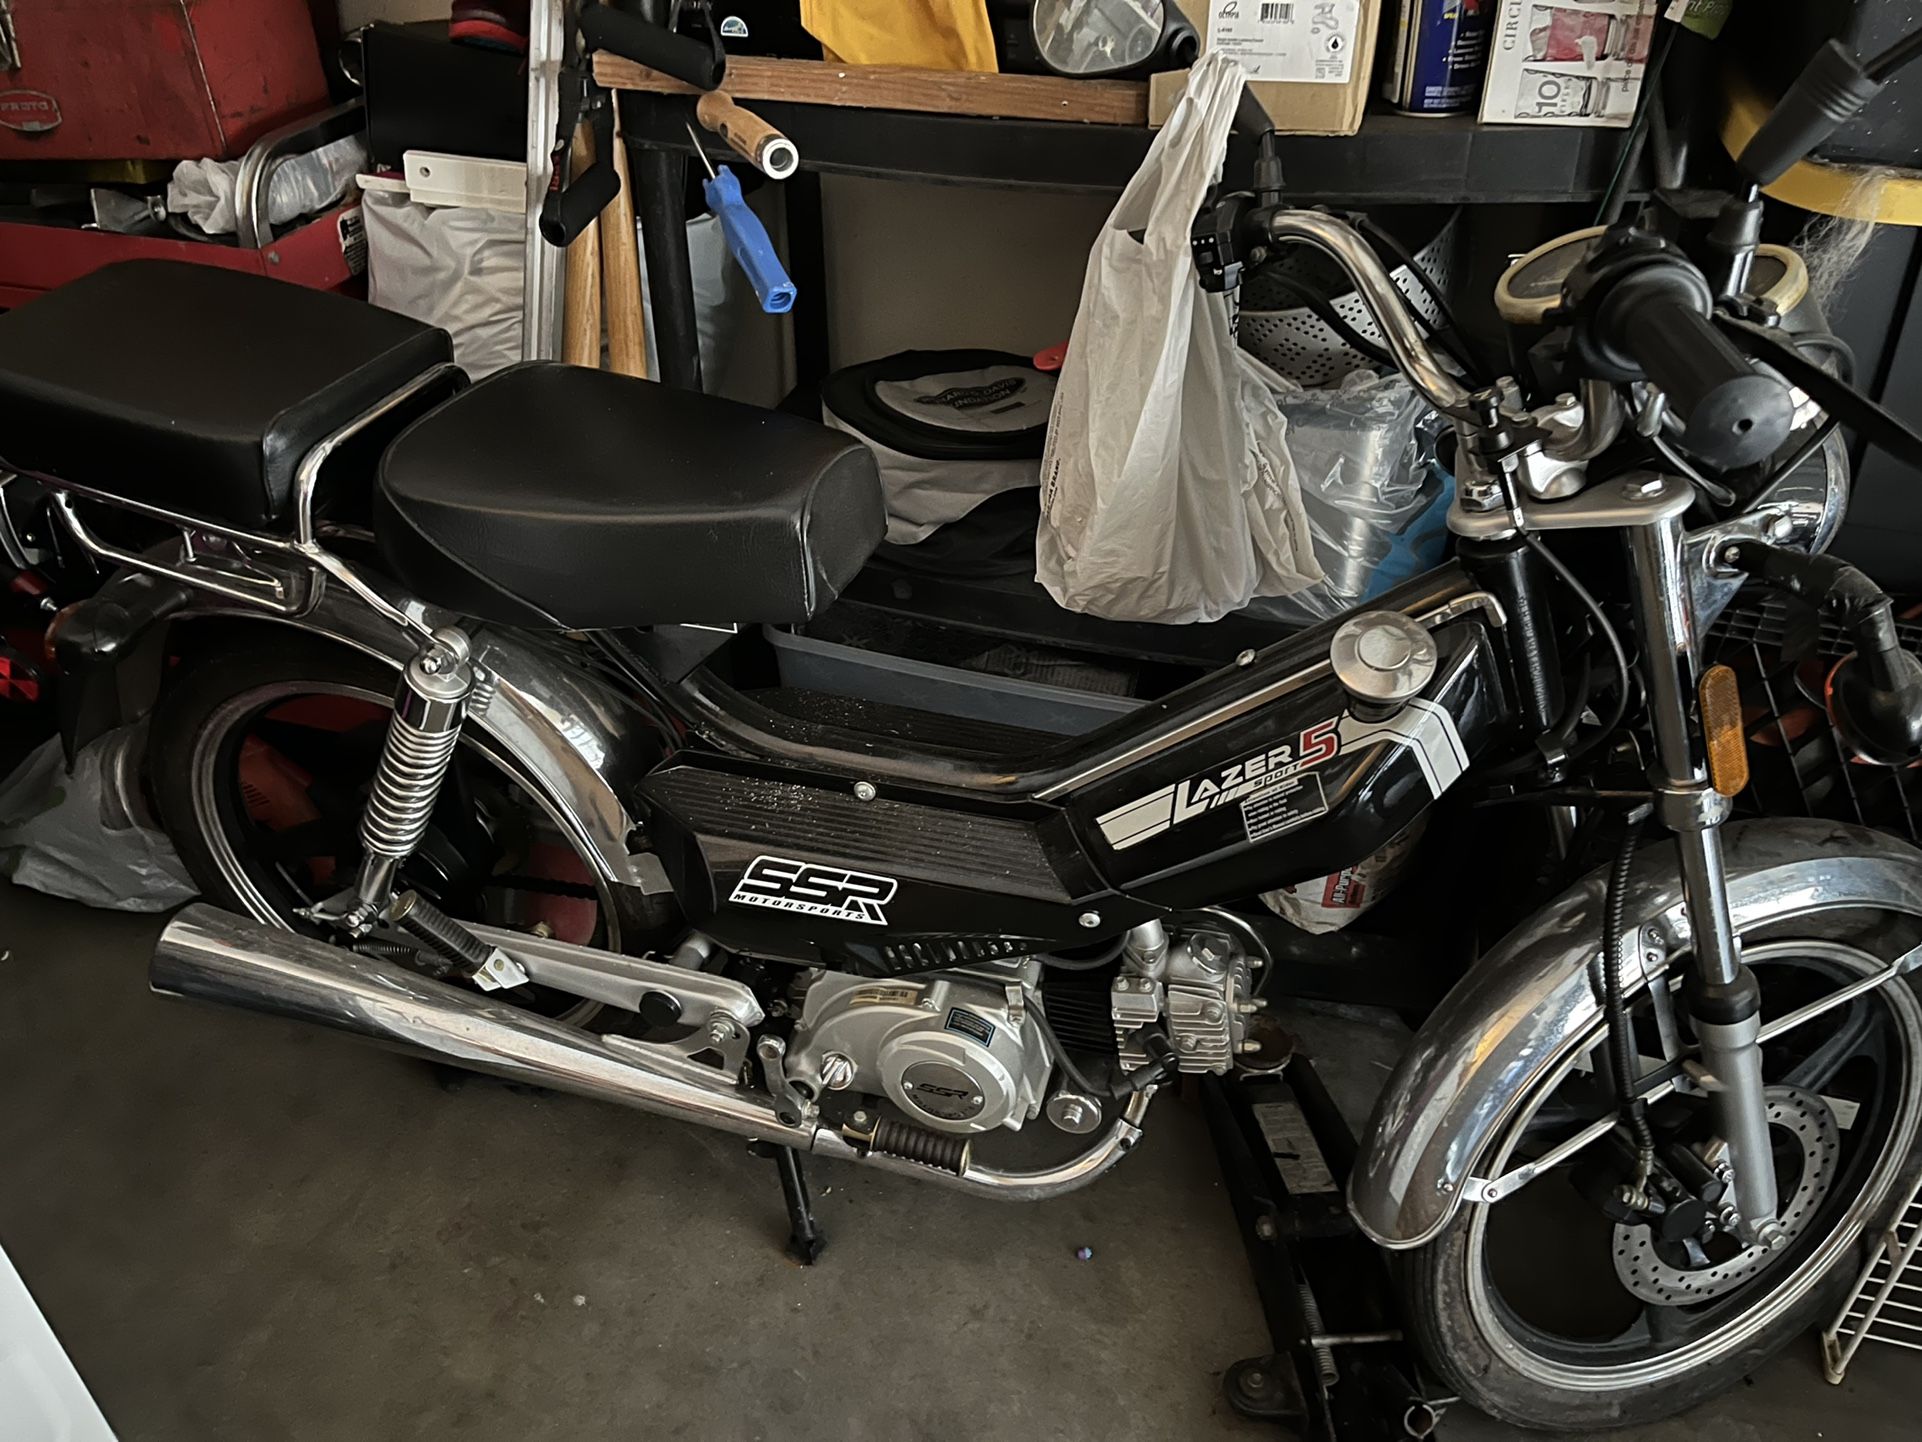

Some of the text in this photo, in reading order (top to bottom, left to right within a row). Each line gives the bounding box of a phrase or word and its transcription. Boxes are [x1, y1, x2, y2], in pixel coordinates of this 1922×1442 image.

[1536, 80, 1561, 114] 10
[1173, 744, 1293, 825] LAZER
[1300, 715, 1341, 768] 5
[733, 893, 866, 921] MOTORSPORTS
[735, 855, 898, 926] SSR
[915, 1083, 969, 1100] SSR
